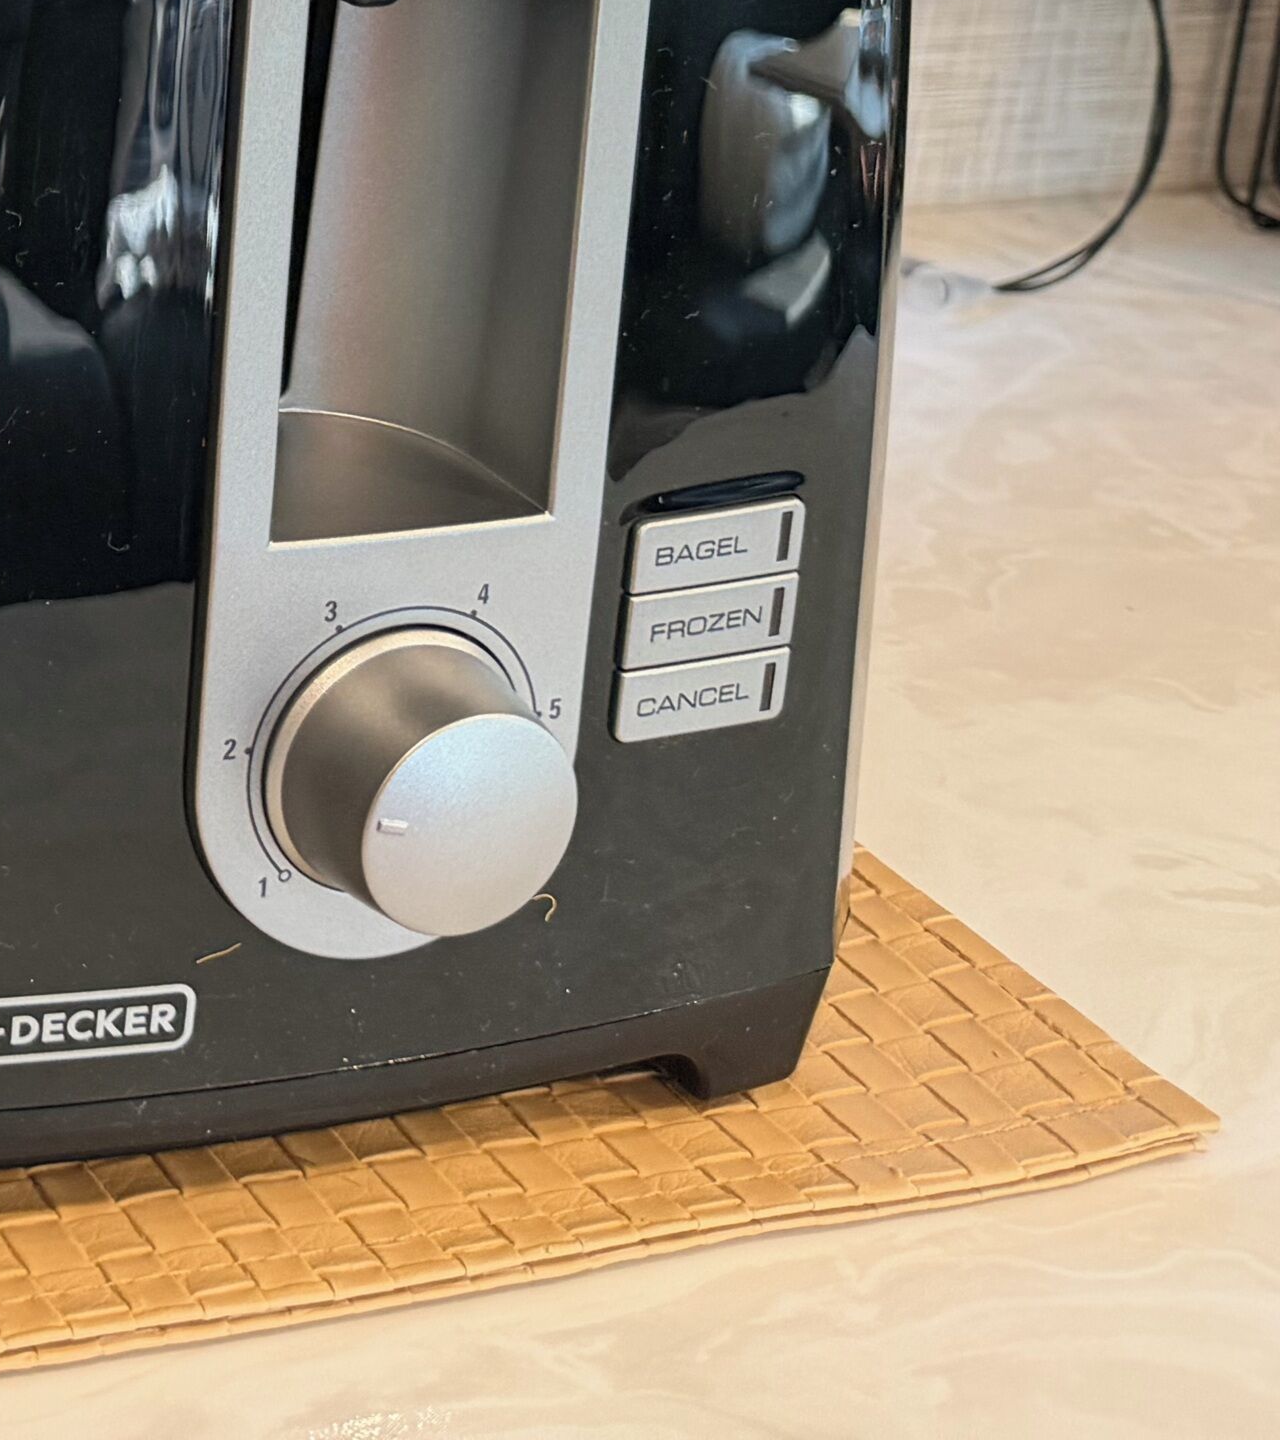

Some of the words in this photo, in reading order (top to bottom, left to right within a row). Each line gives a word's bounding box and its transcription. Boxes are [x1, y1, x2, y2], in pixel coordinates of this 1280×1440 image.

[654, 535, 748, 567] BAGEL
[477, 583, 490, 605] 4
[324, 600, 338, 622] 3
[649, 605, 763, 643] FROZEN
[549, 698, 562, 719] 5
[636, 682, 750, 718] CANCEL
[223, 738, 237, 760] 2
[257, 876, 268, 898] 1
